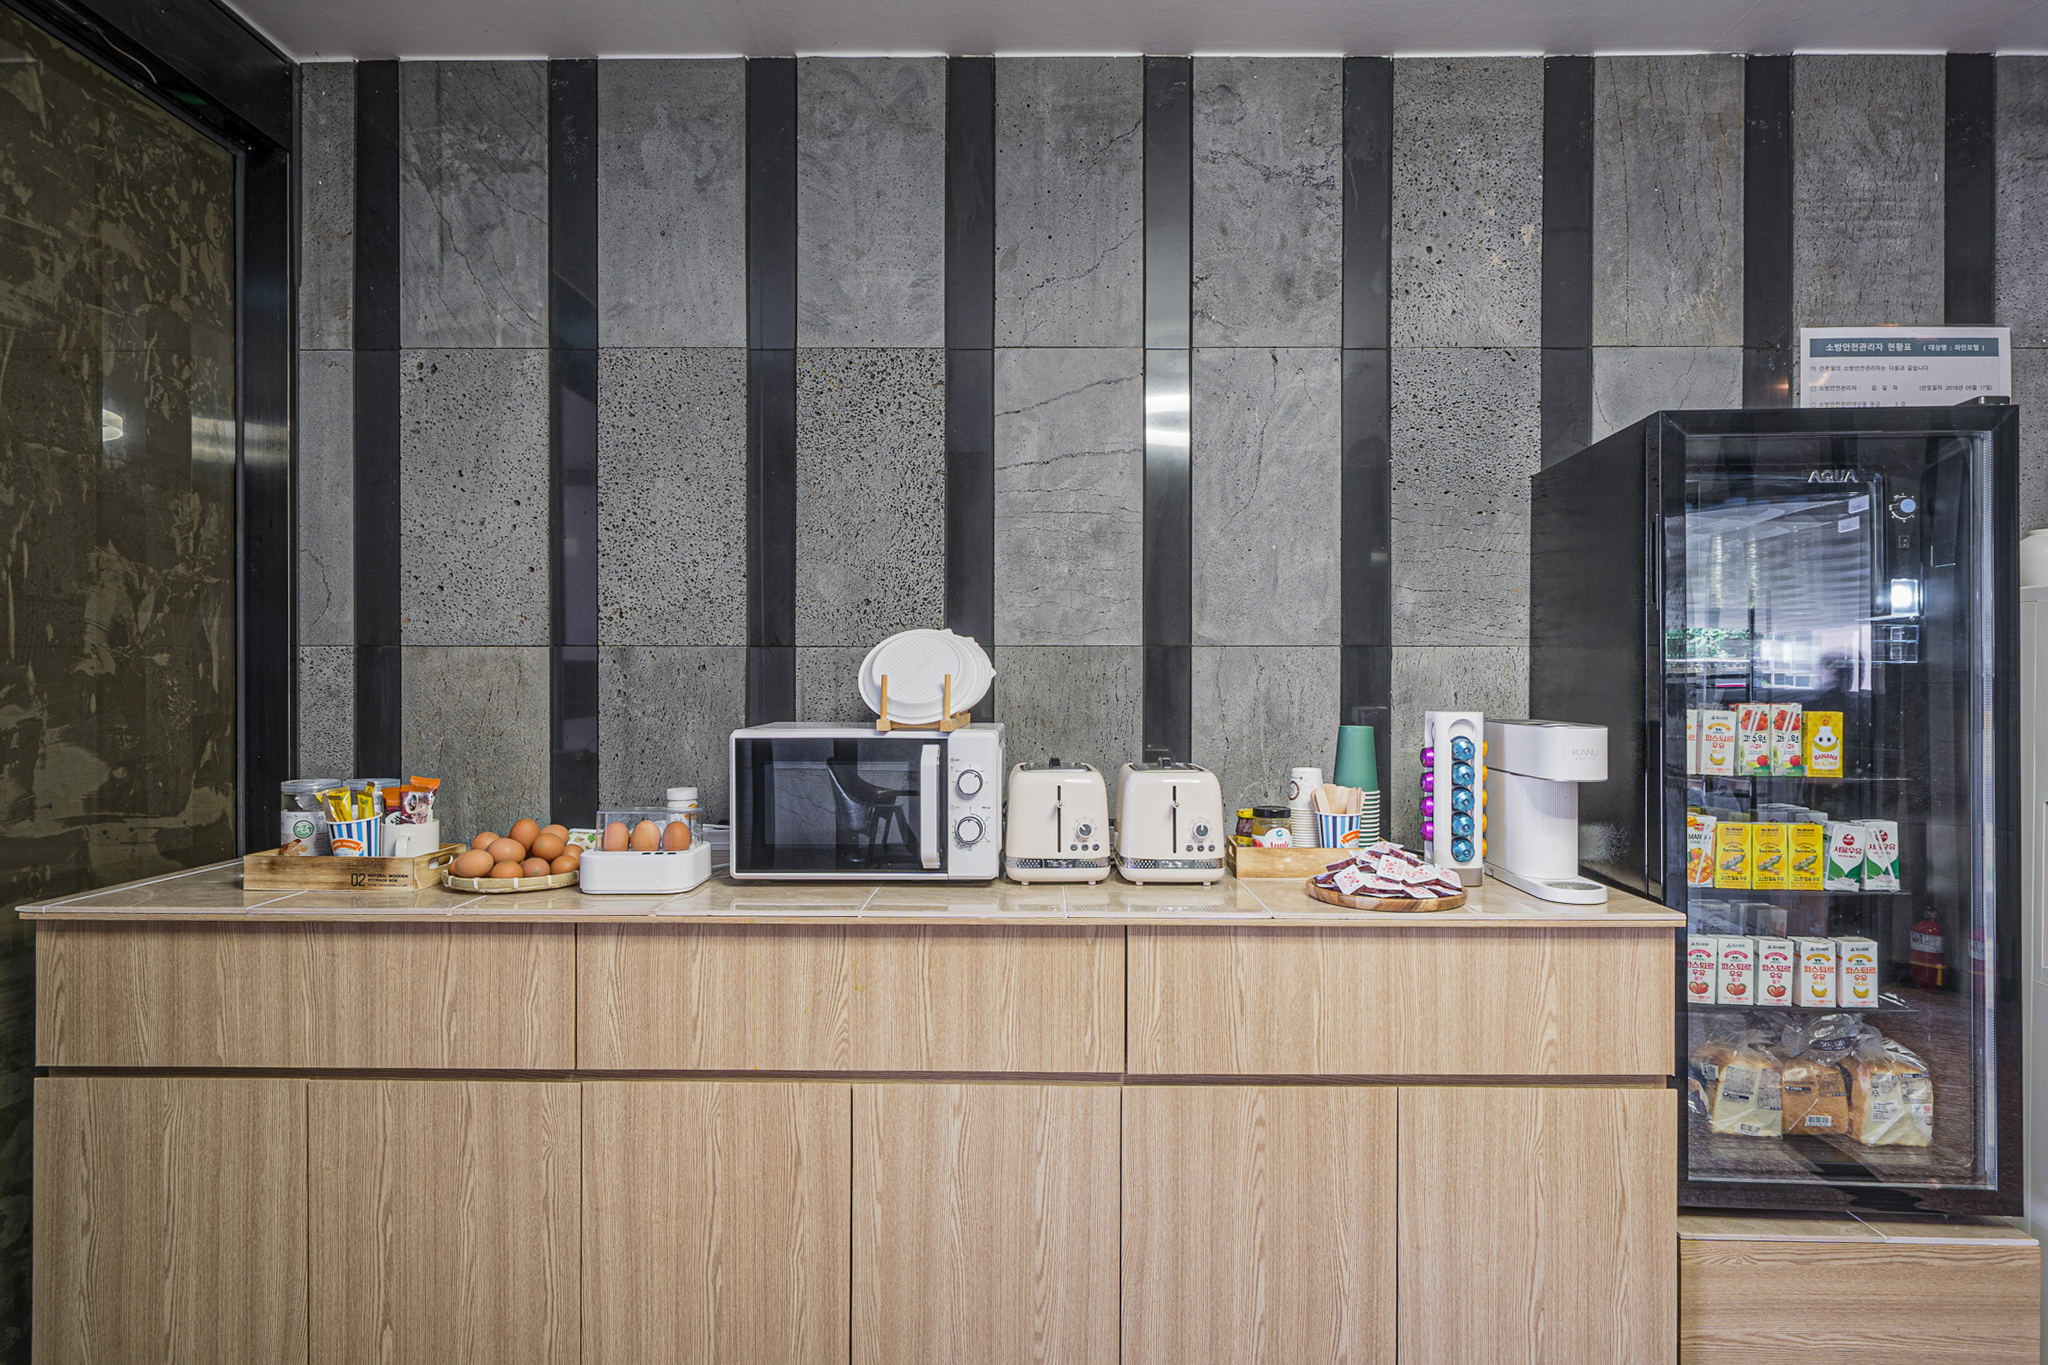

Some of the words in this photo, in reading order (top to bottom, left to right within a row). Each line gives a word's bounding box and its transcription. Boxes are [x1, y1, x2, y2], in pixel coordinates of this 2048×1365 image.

[1826, 342, 1883, 352] 소방안전관리자
[1887, 342, 1912, 352] 현황표
[1808, 469, 1858, 483] AQUA
[1705, 734, 1734, 742] 파스퇴르
[1834, 846, 1862, 854] 서울우유
[351, 873, 366, 886] 02
[1721, 963, 1752, 971] 파스퇴르
[1762, 964, 1791, 972] 파스퇴르
